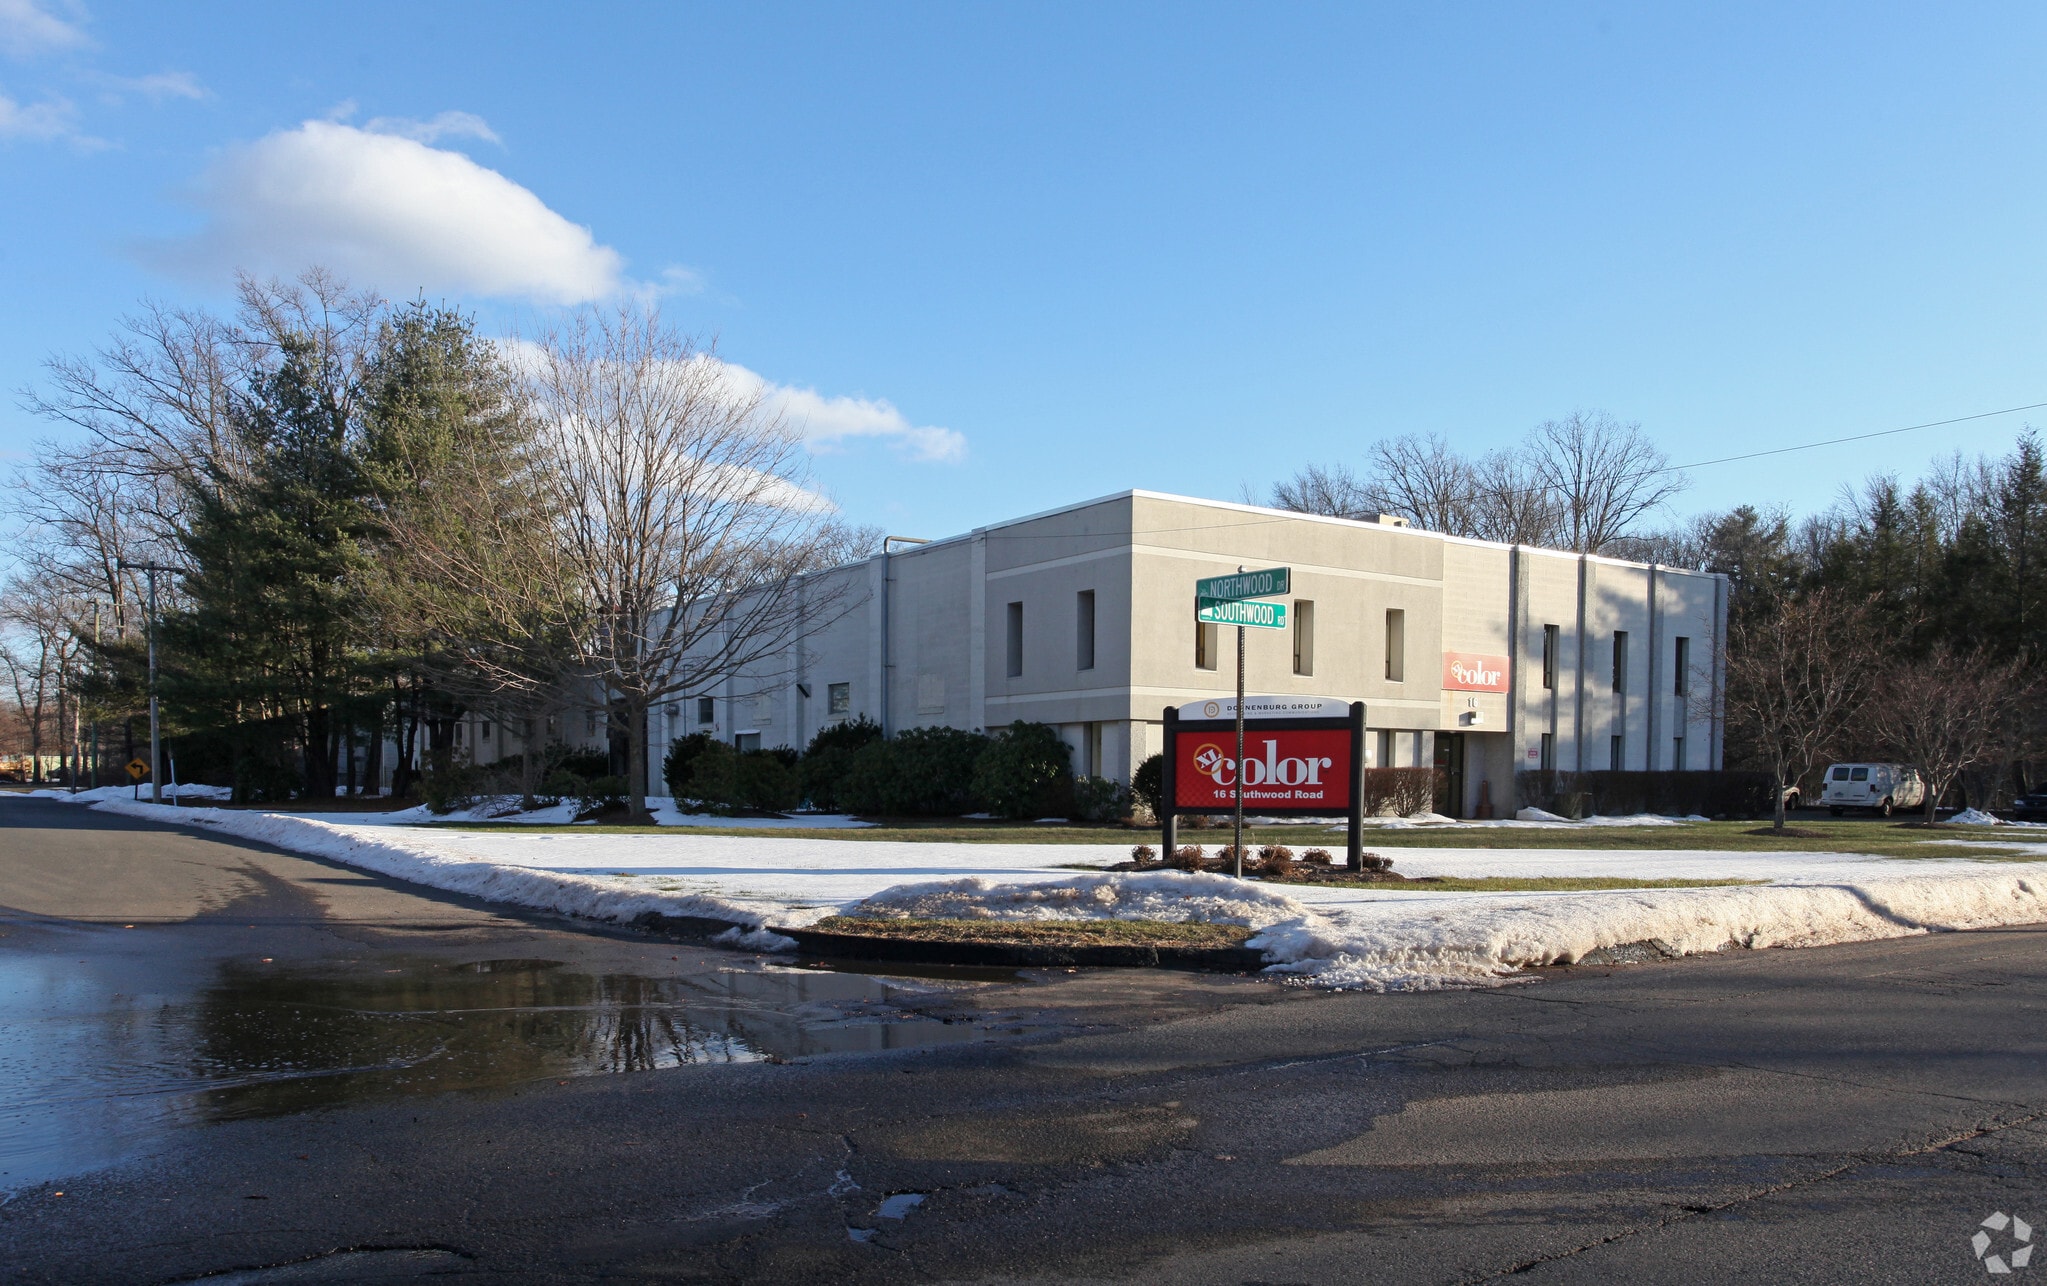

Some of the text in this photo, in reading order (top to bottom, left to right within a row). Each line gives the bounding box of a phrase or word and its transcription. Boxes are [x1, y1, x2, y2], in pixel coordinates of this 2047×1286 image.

[1210, 573, 1285, 598] NORTHWOOD DR
[1214, 600, 1285, 626] SOUTHWOOD RD
[1457, 660, 1501, 686] color
[1226, 703, 1288, 711] DONENBURG
[1195, 739, 1332, 786] XL color
[1213, 789, 1324, 799] 16 Suthwood Road
